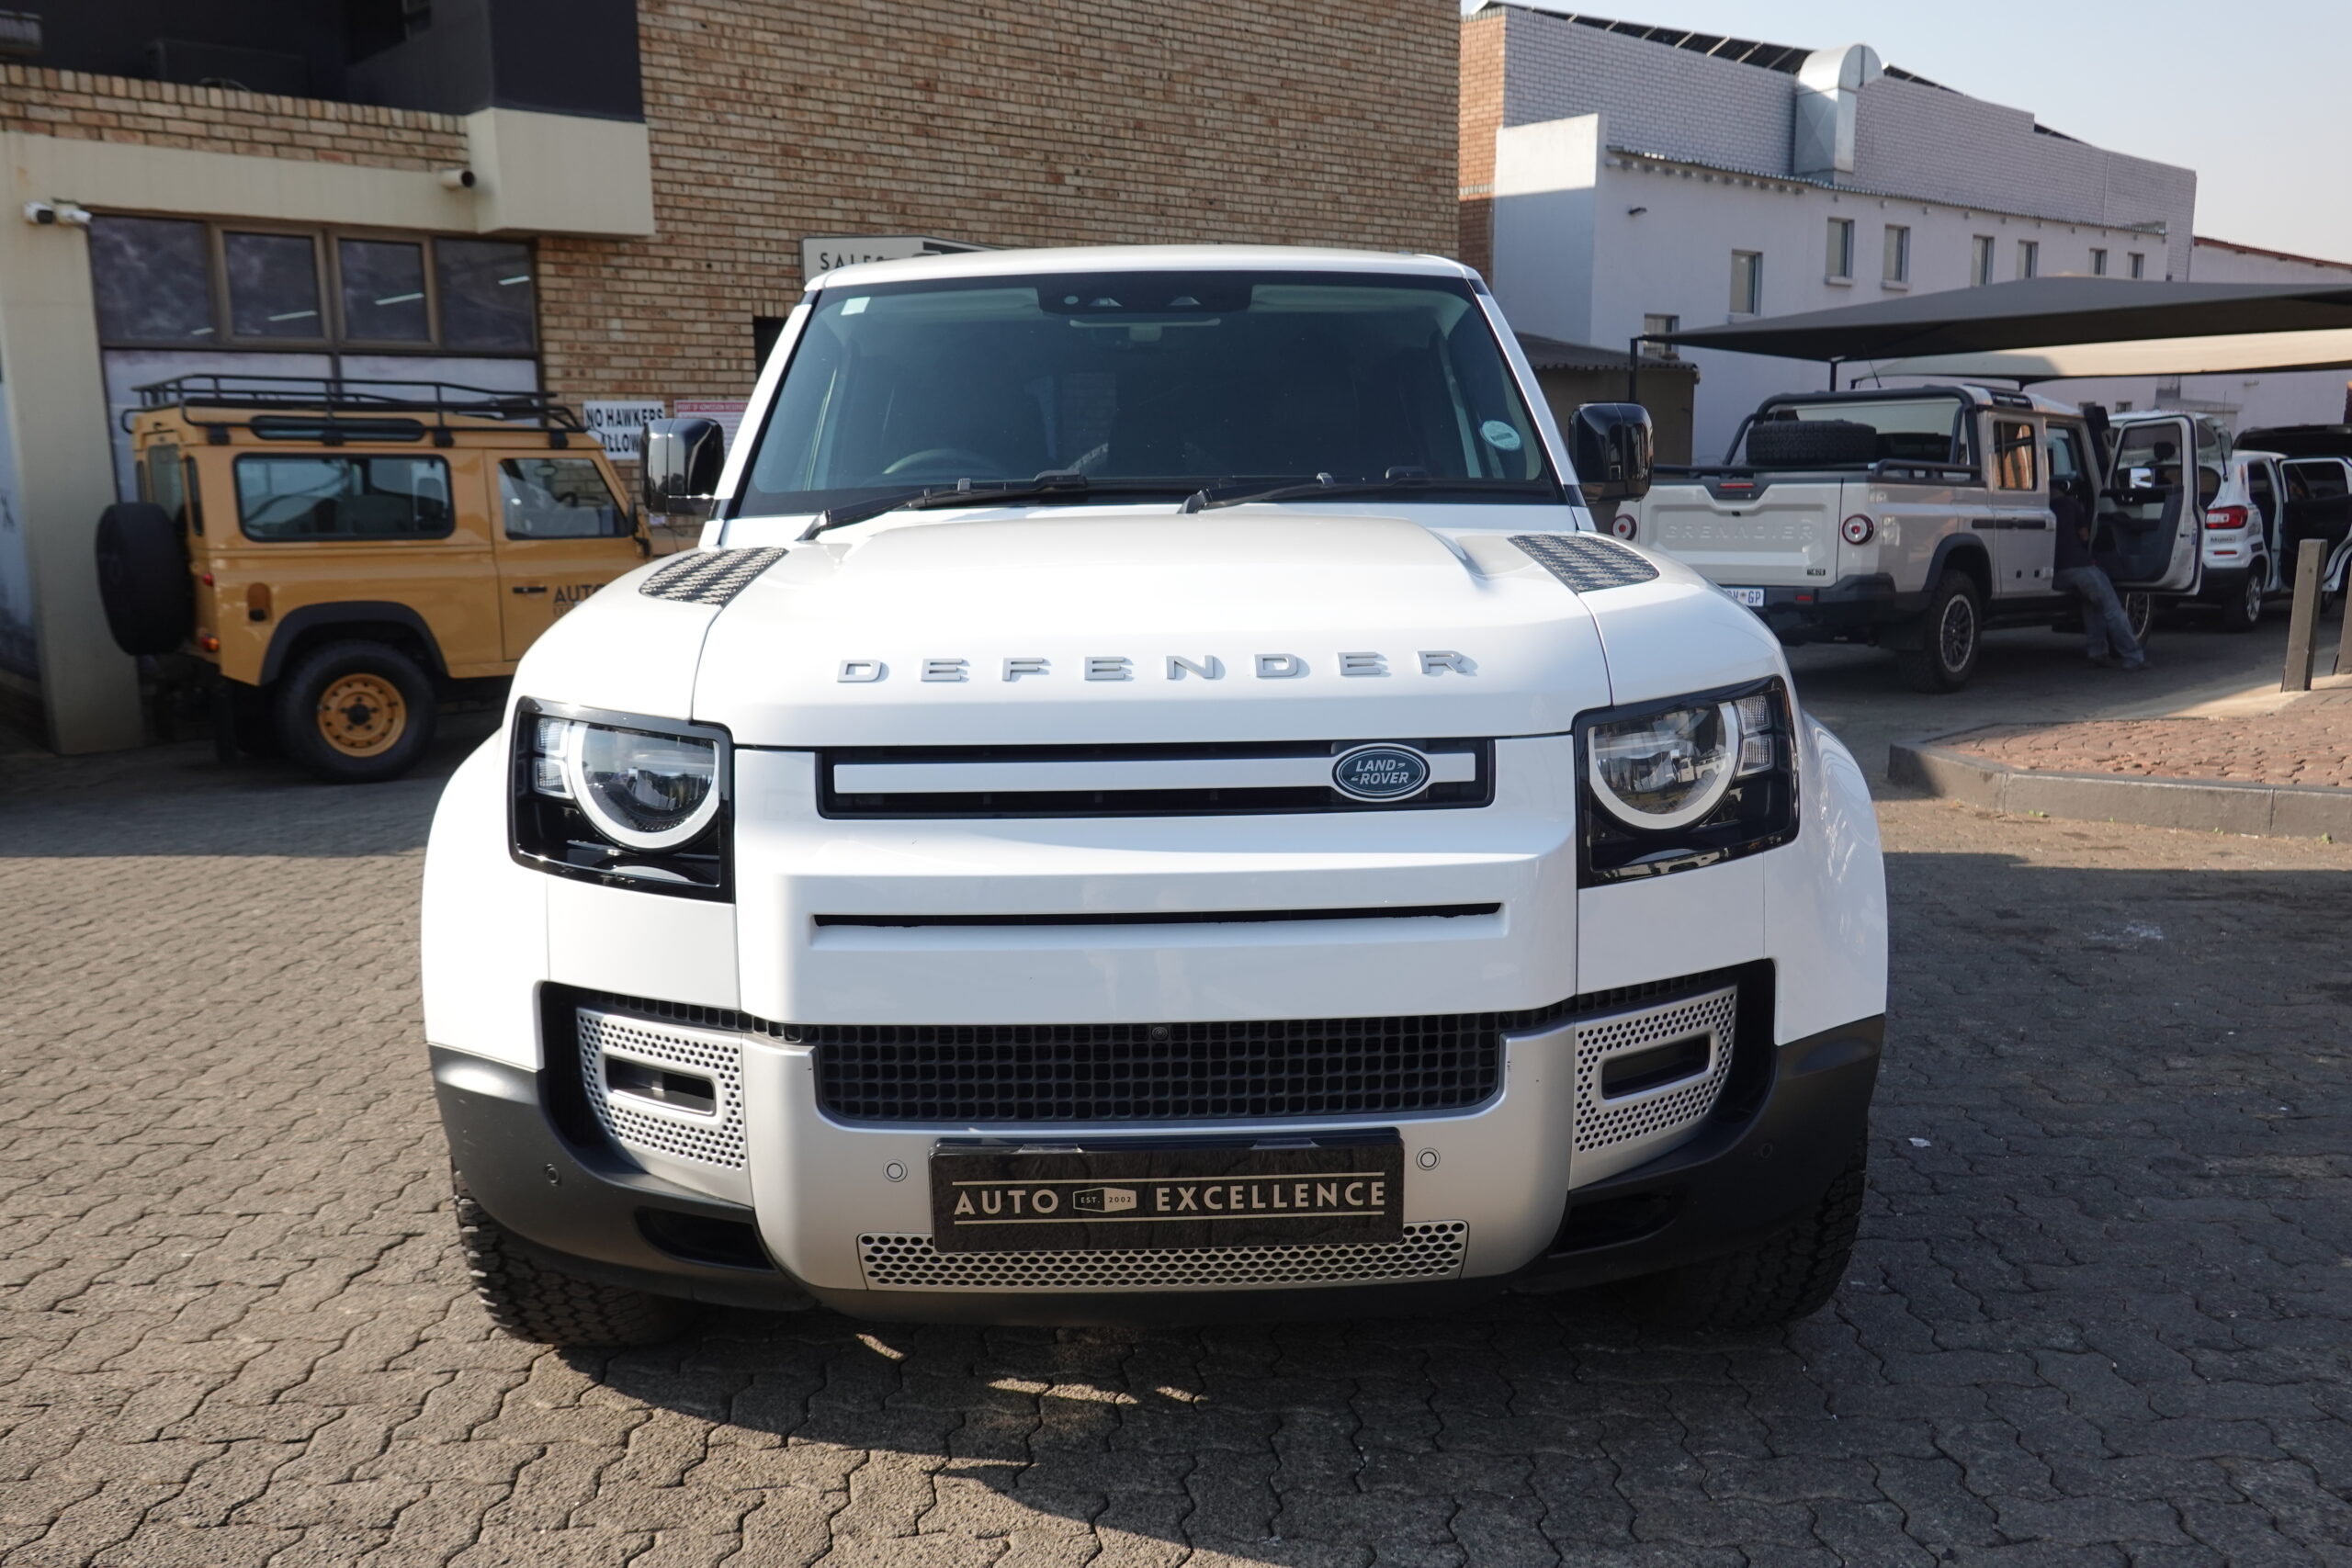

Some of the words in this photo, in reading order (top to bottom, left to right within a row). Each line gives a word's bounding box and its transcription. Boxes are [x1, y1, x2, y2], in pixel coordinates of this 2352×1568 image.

[585, 408, 603, 427] NO
[601, 433, 639, 453] ALLOW
[1747, 591, 1761, 604] GP
[836, 649, 1470, 683] DEFENDER
[954, 1189, 1059, 1215] AUTO
[1080, 1196, 1101, 1204] EST.
[1108, 1195, 1132, 1204] 2002
[1156, 1181, 1385, 1212] EXCELLENCE
